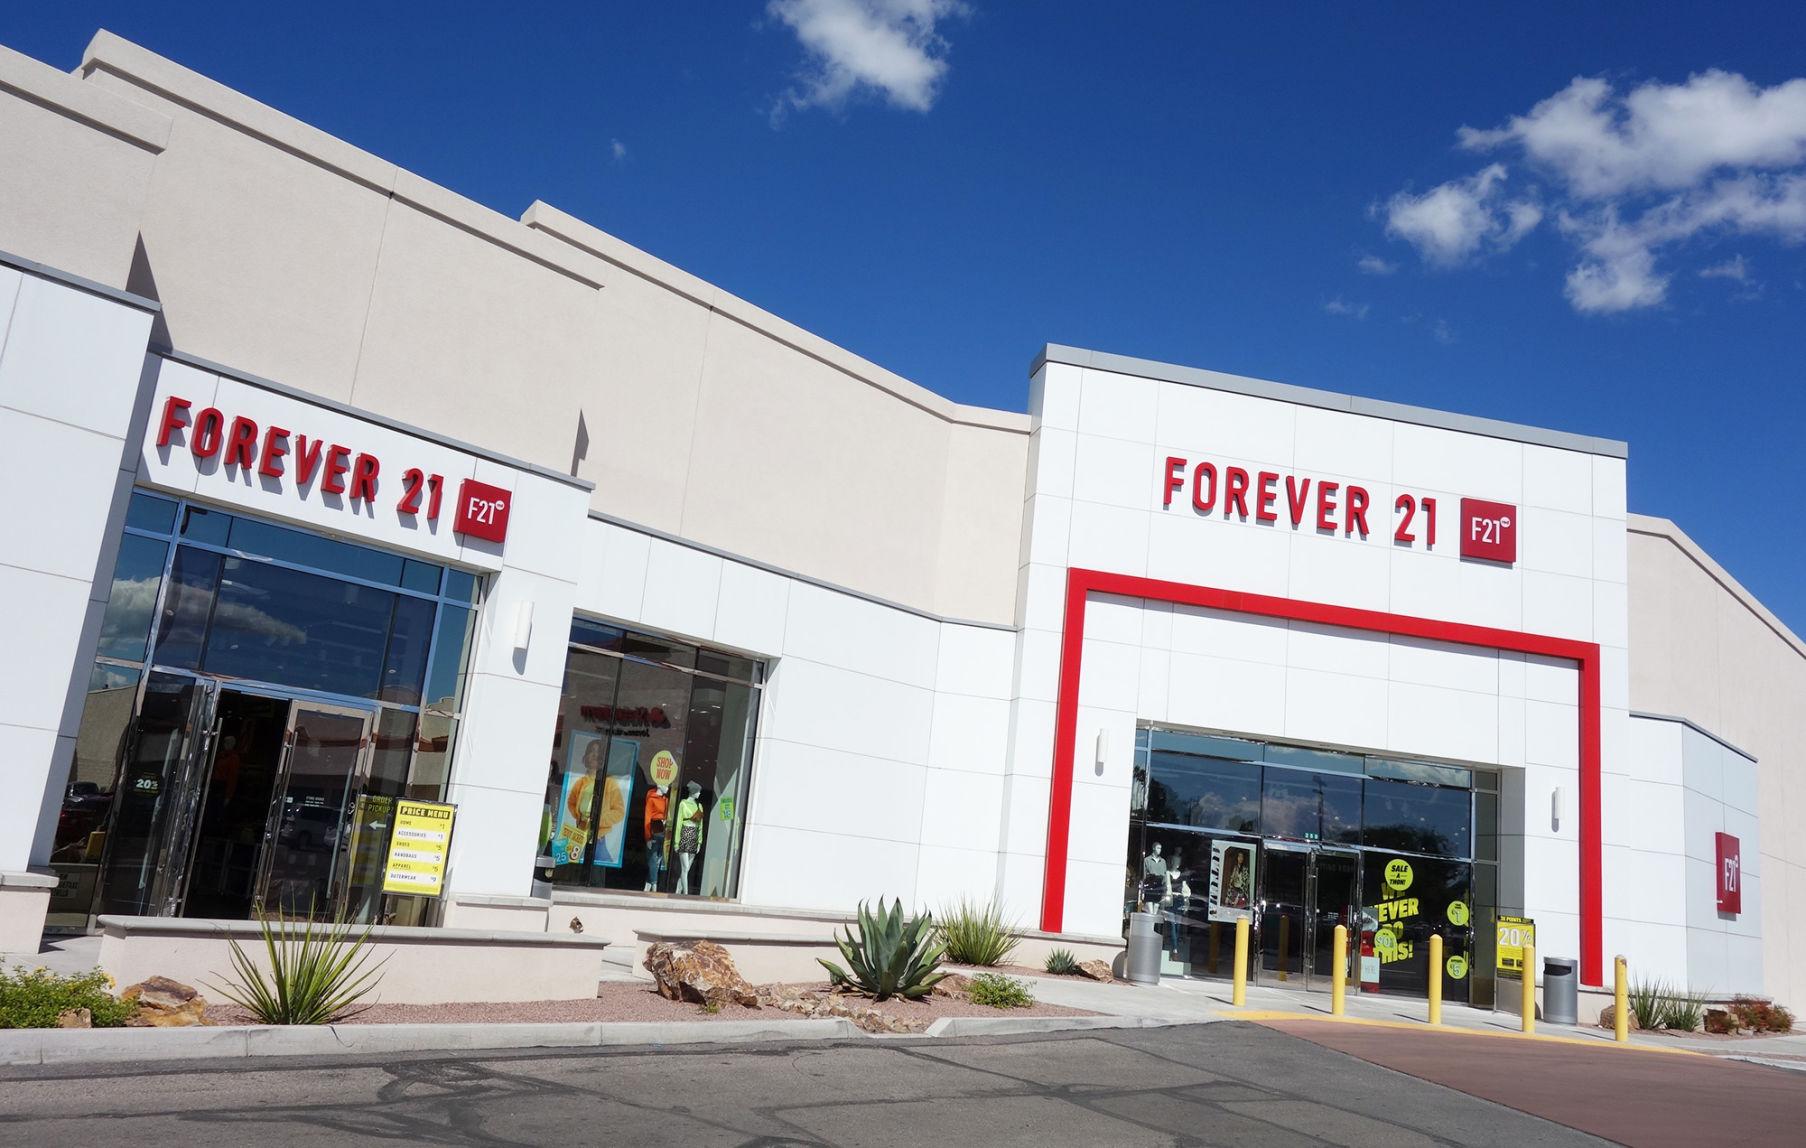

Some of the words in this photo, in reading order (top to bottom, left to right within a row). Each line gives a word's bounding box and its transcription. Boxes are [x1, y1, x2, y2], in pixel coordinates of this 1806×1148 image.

[156, 395, 380, 502] FOREVER
[396, 468, 444, 520] 21
[1163, 456, 1370, 535] FOREVER
[1394, 493, 1436, 545] 21
[1471, 516, 1501, 545] F21
[401, 806, 426, 817] PRICE
[427, 809, 449, 819] MENU
[1372, 897, 1419, 922] EVER
